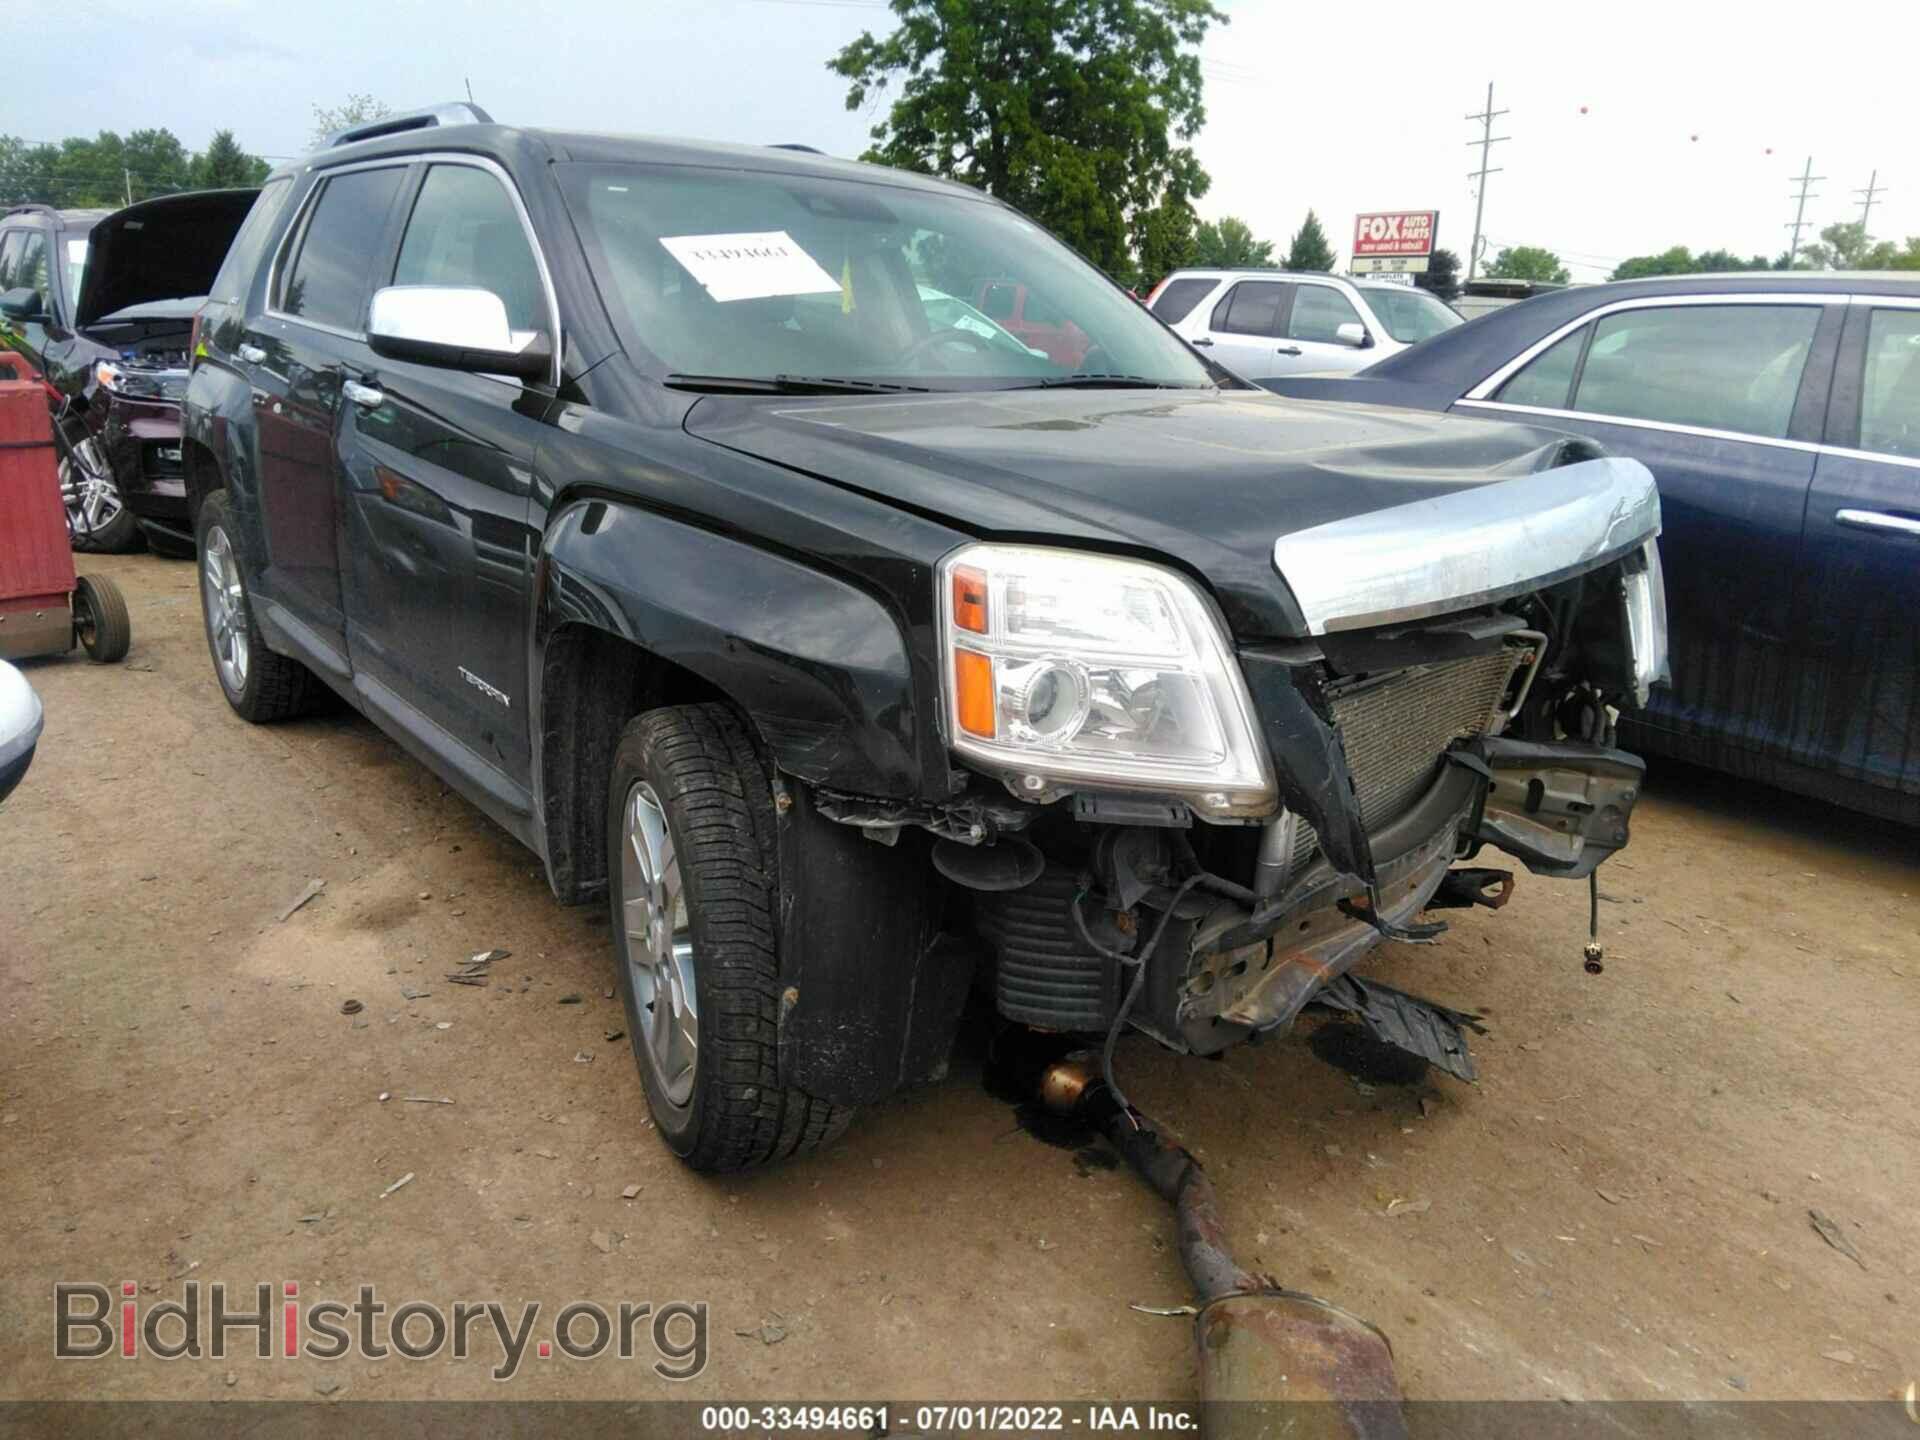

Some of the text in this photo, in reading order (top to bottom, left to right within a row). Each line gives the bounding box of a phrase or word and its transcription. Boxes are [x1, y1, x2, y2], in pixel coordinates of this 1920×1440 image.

[1403, 215, 1429, 227] AUTO
[1358, 216, 1401, 241] FOX
[1401, 227, 1430, 239] PARTS
